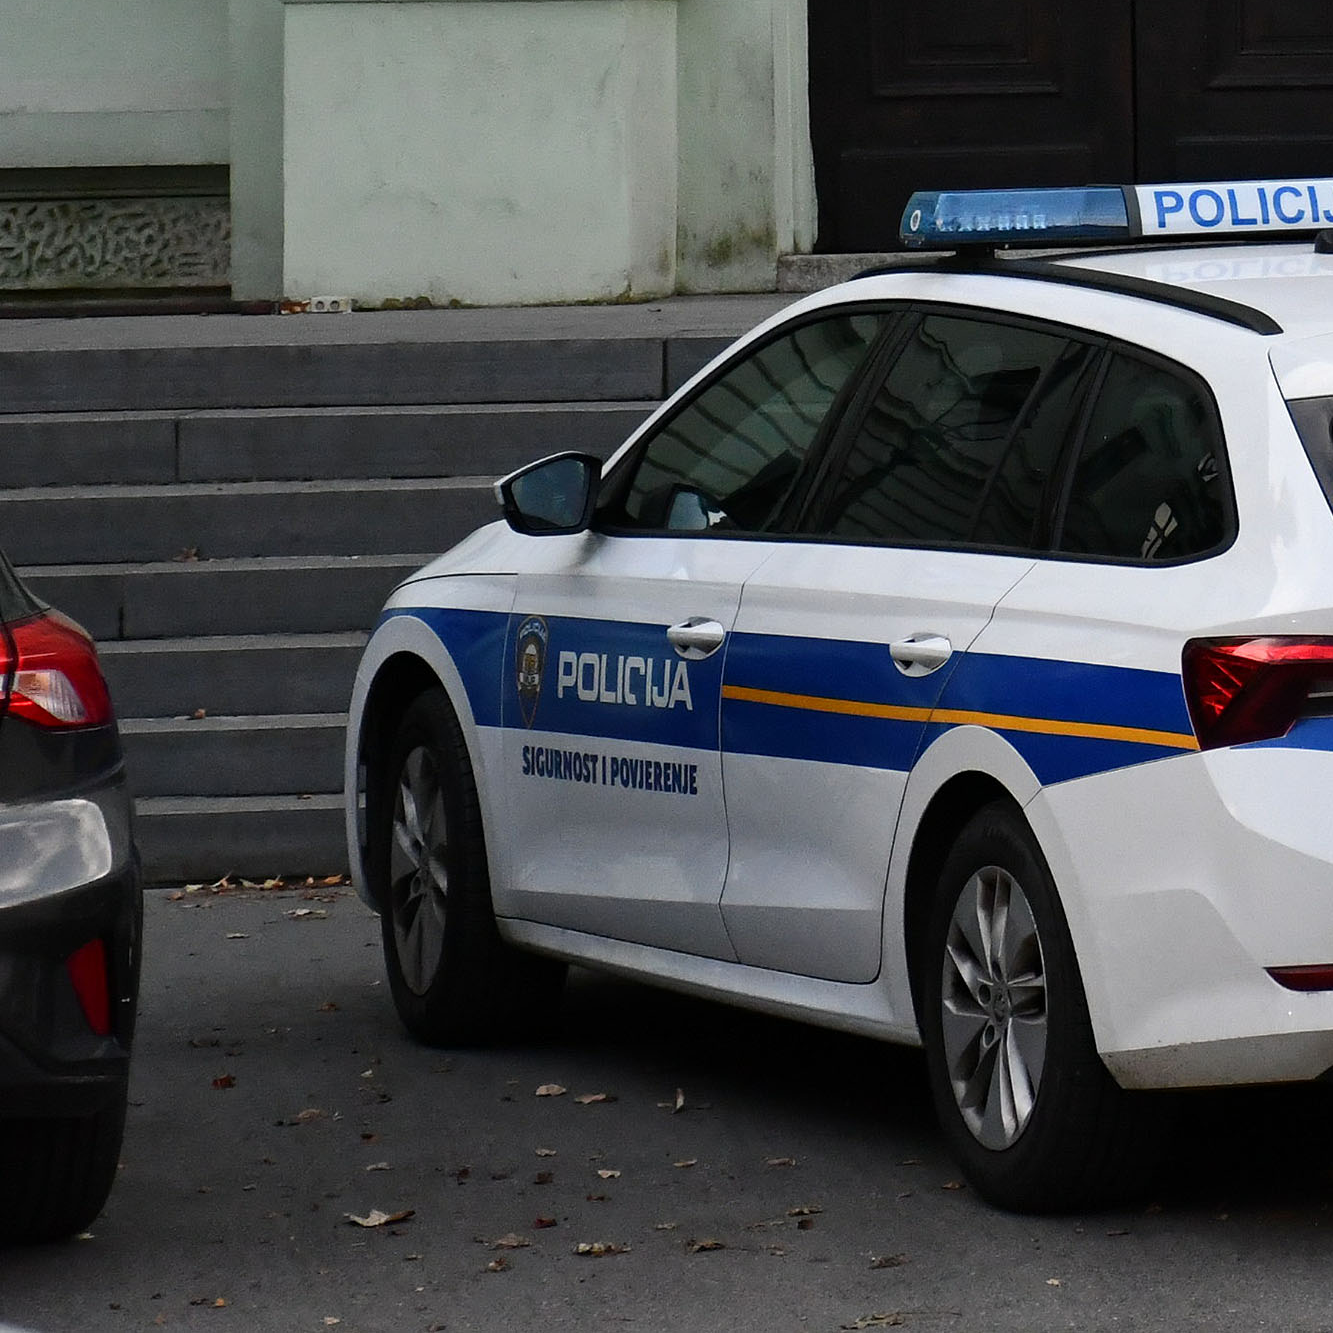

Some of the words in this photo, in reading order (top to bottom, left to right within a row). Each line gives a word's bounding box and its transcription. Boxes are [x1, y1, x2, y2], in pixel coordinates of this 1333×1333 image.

[557, 651, 693, 711] POLICIJA
[522, 745, 598, 784] SIGURNOST
[602, 756, 607, 785] I
[610, 757, 698, 795] POVJERENJE
